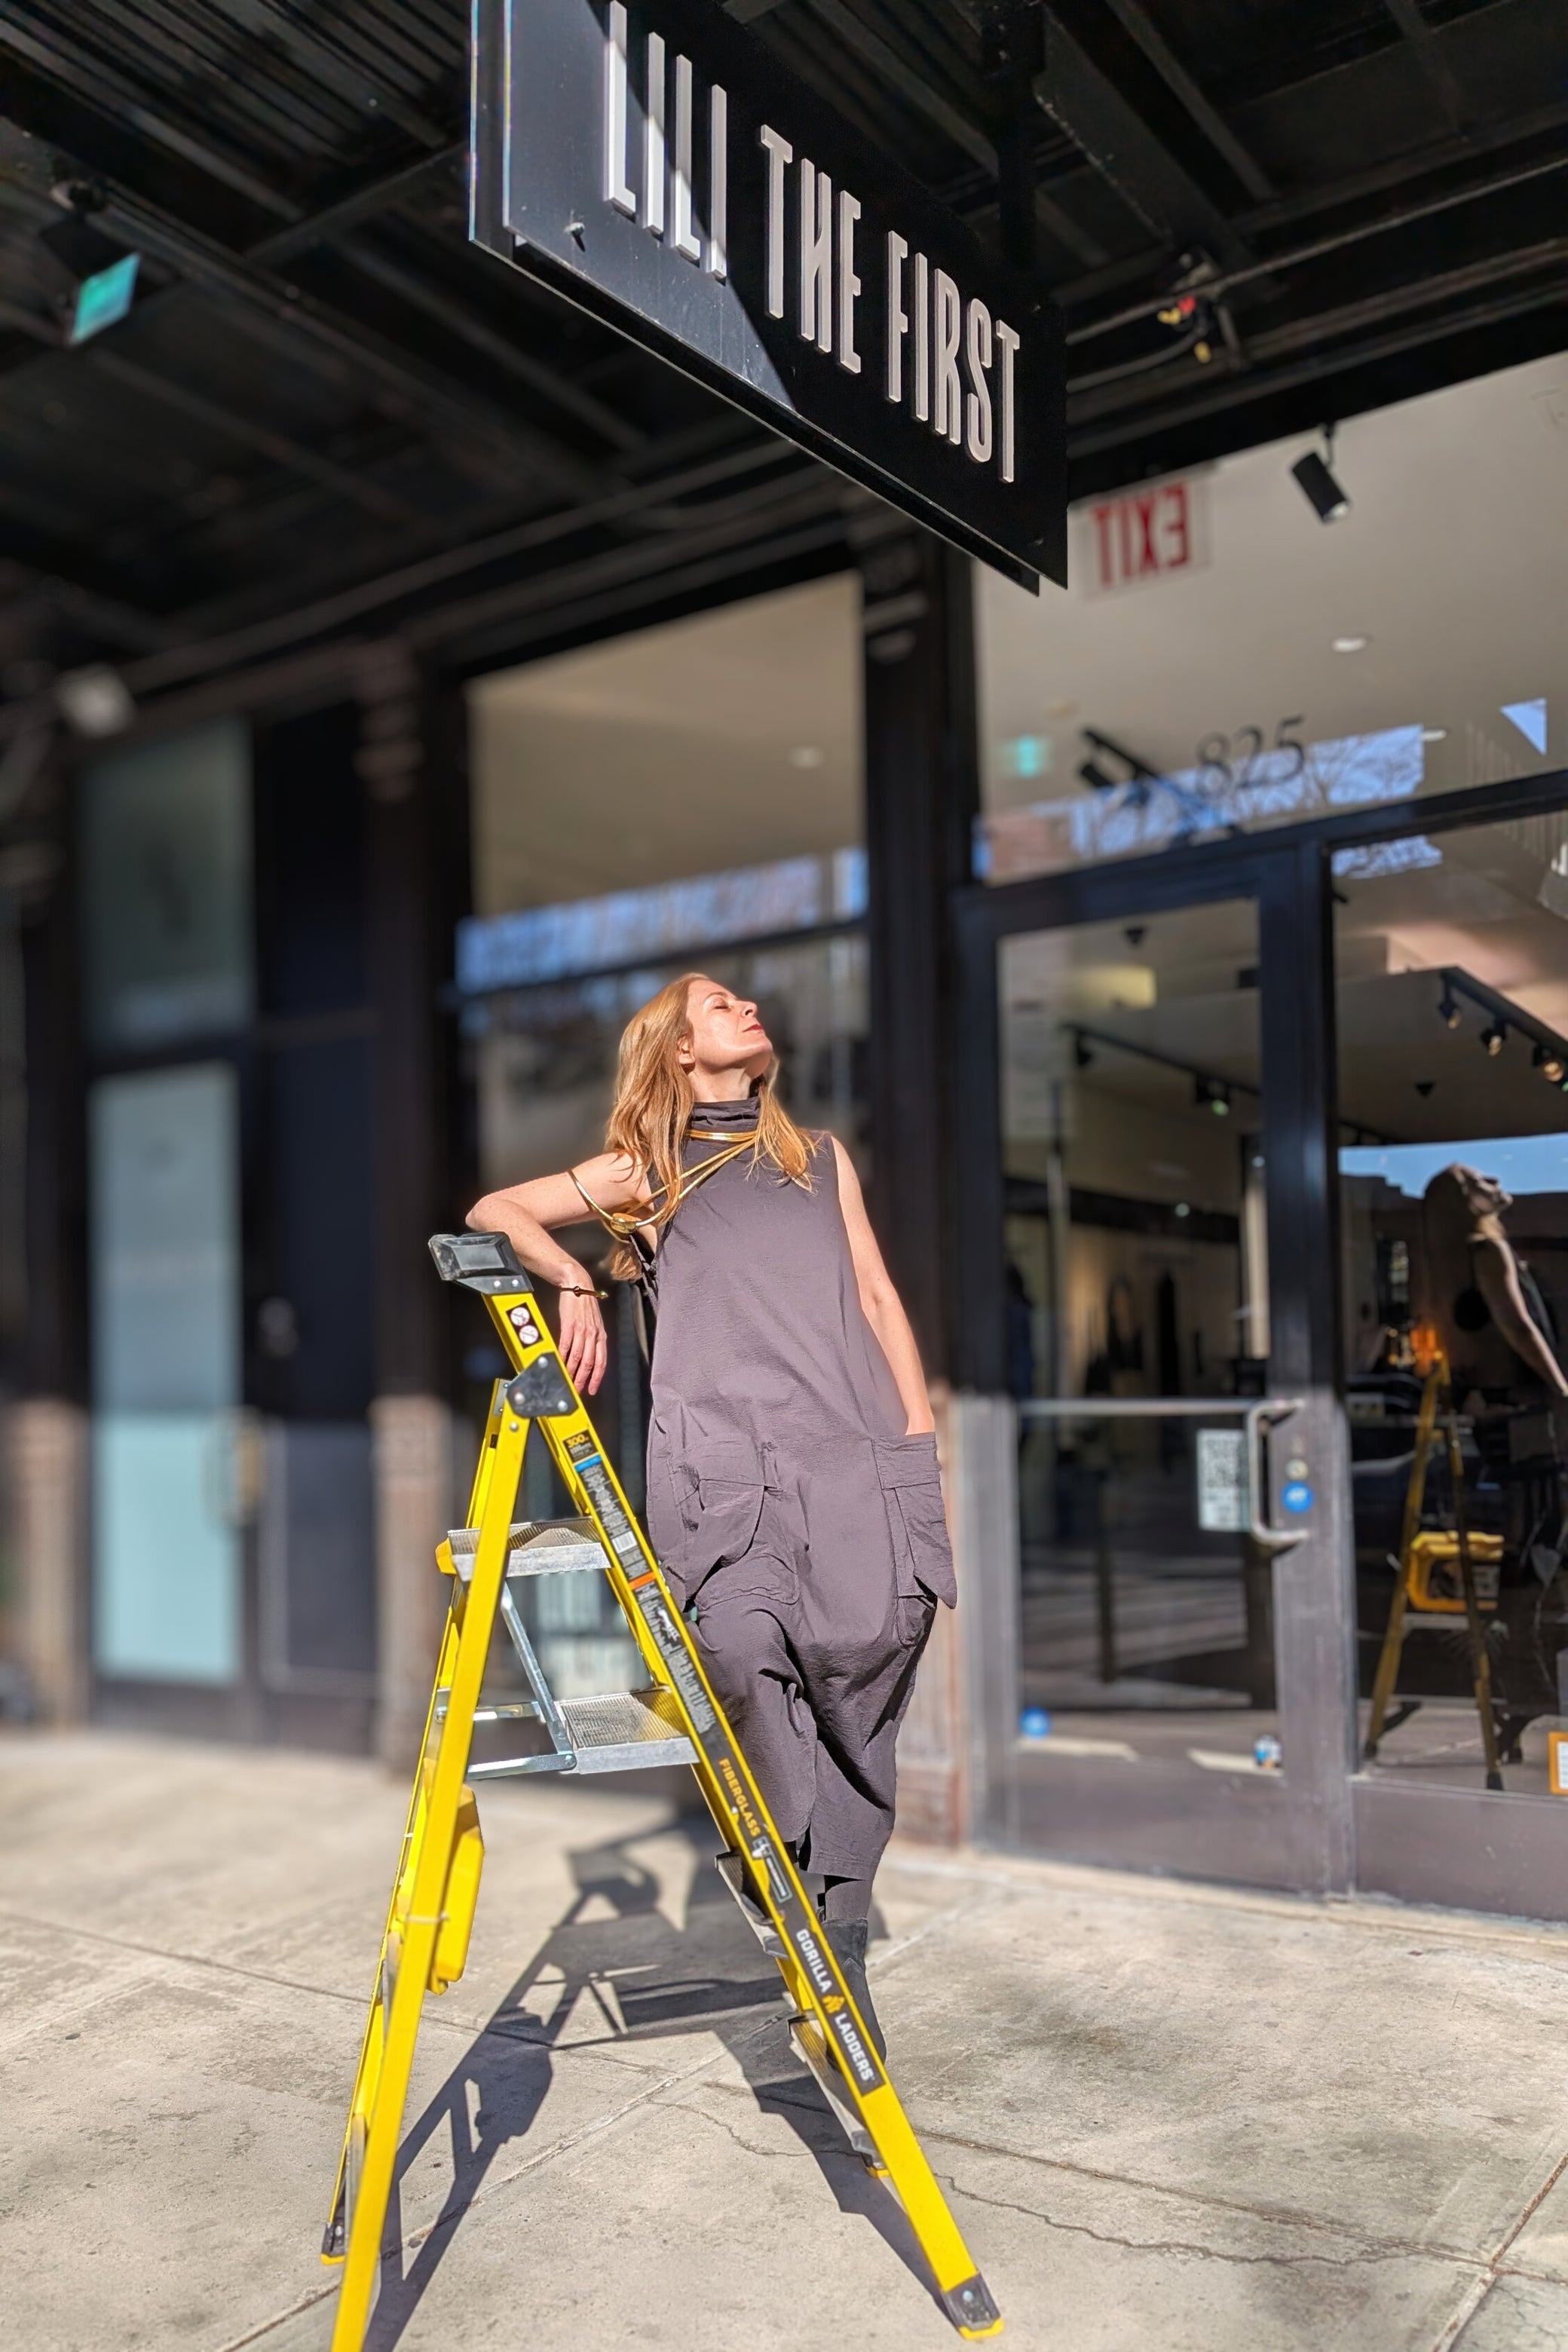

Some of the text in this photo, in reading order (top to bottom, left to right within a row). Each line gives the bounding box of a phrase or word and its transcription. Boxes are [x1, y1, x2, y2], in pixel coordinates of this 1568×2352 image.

[604, 0, 1021, 484] LILI THE FIRST
[1195, 715, 1306, 796] 825
[566, 1435, 586, 1447] 300
[719, 1759, 761, 1837] FIBERGLASS
[795, 1928, 874, 2082] GORILLA LADDERS
